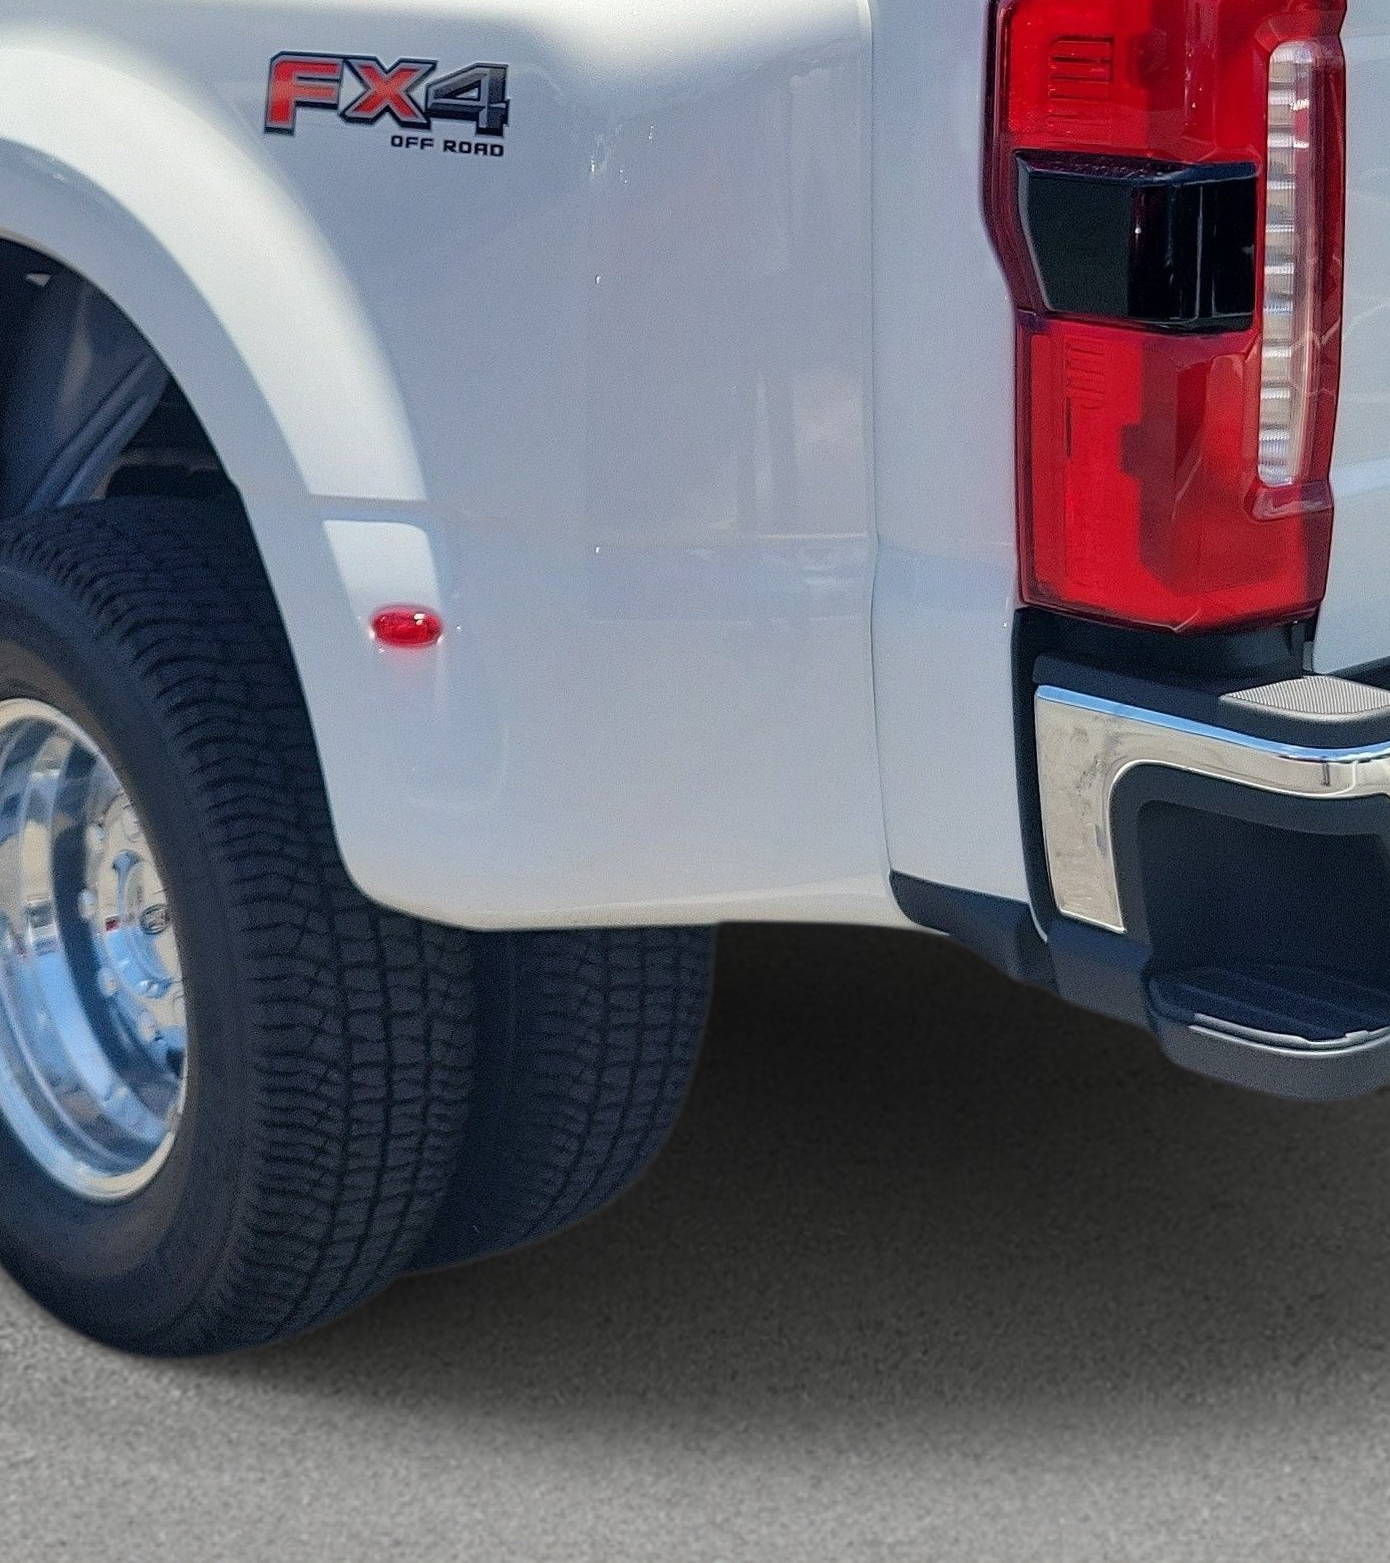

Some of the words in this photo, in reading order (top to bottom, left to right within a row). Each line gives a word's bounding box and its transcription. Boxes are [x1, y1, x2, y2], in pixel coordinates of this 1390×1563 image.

[264, 50, 509, 136] FX4
[391, 135, 434, 150] OFF
[443, 139, 504, 157] ROAD
